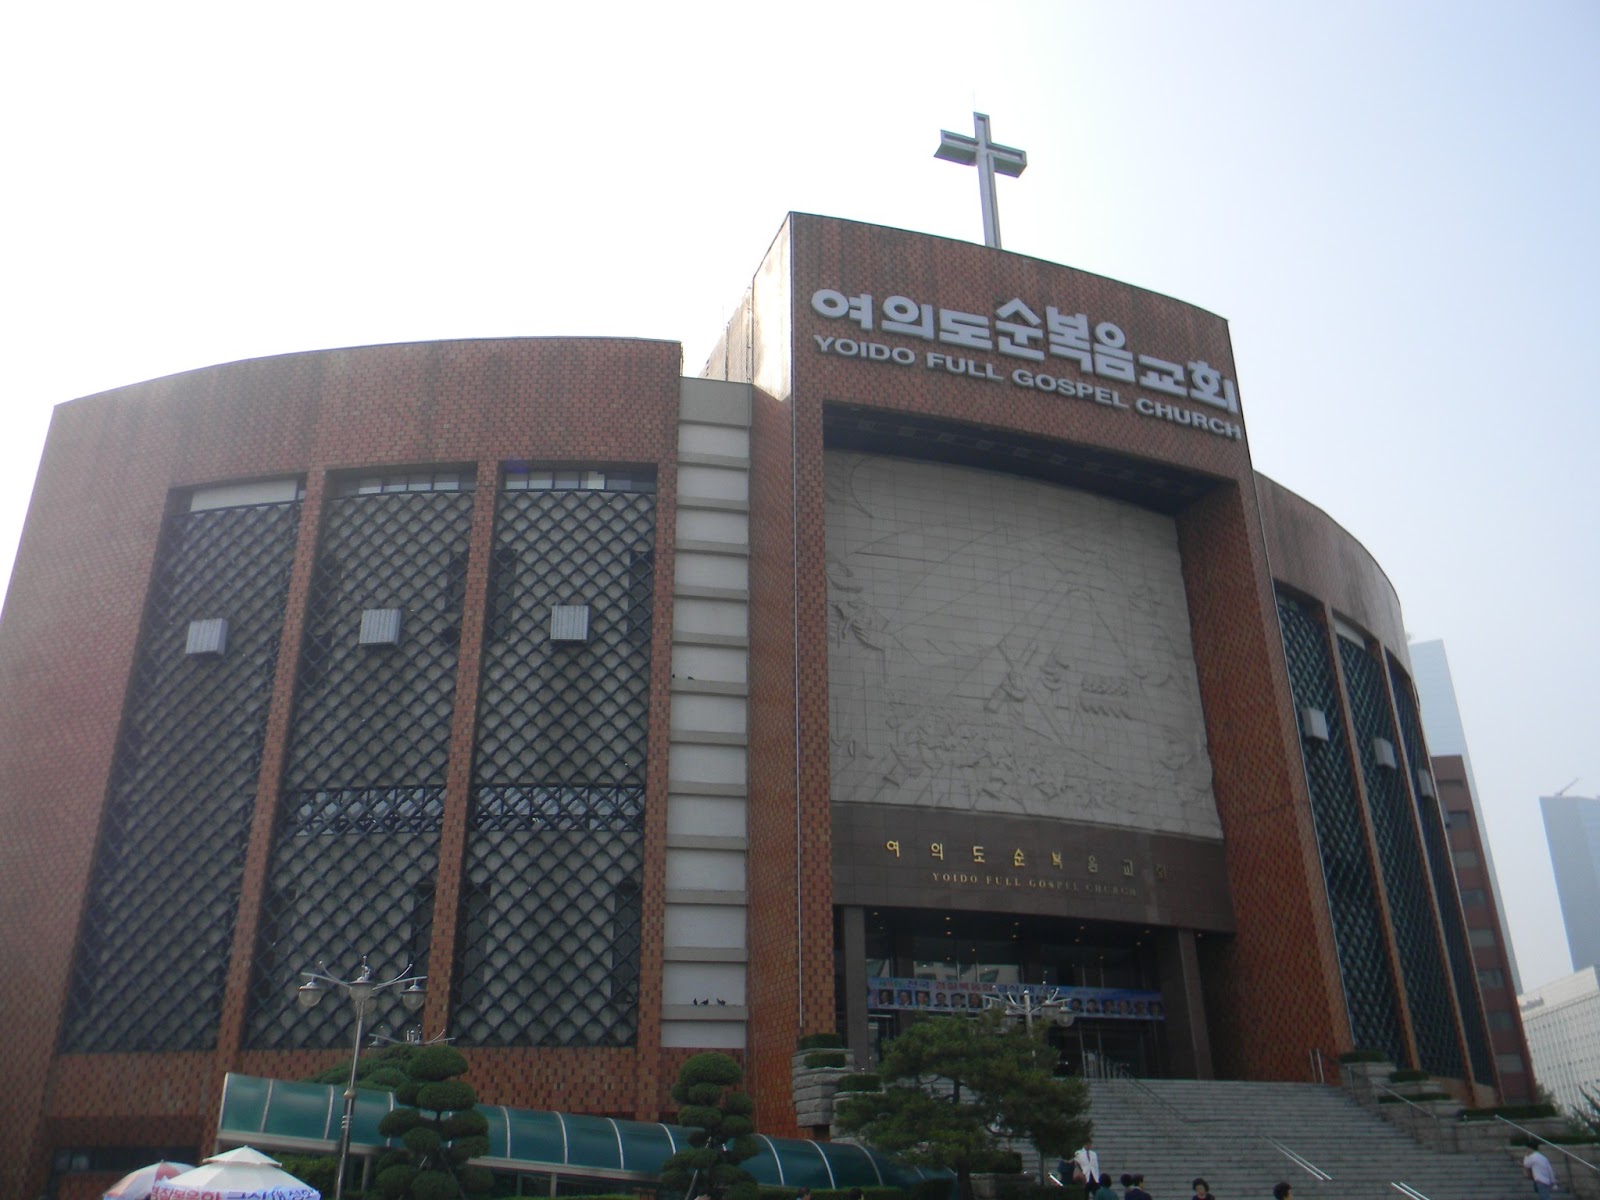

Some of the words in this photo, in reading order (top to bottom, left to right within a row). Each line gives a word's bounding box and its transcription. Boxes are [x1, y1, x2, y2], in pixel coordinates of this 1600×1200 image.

[811, 288, 1239, 414] 여의도순복음교회
[813, 334, 916, 365] YOIDO
[926, 351, 1005, 380] FULL
[1012, 368, 1129, 409] GOSPEL
[1135, 397, 1242, 441] CHURCH
[932, 872, 978, 884] YOIDO
[986, 876, 1022, 887] FULL
[1029, 879, 1080, 892] GOSPEL
[1086, 883, 1137, 897] CHURCH
